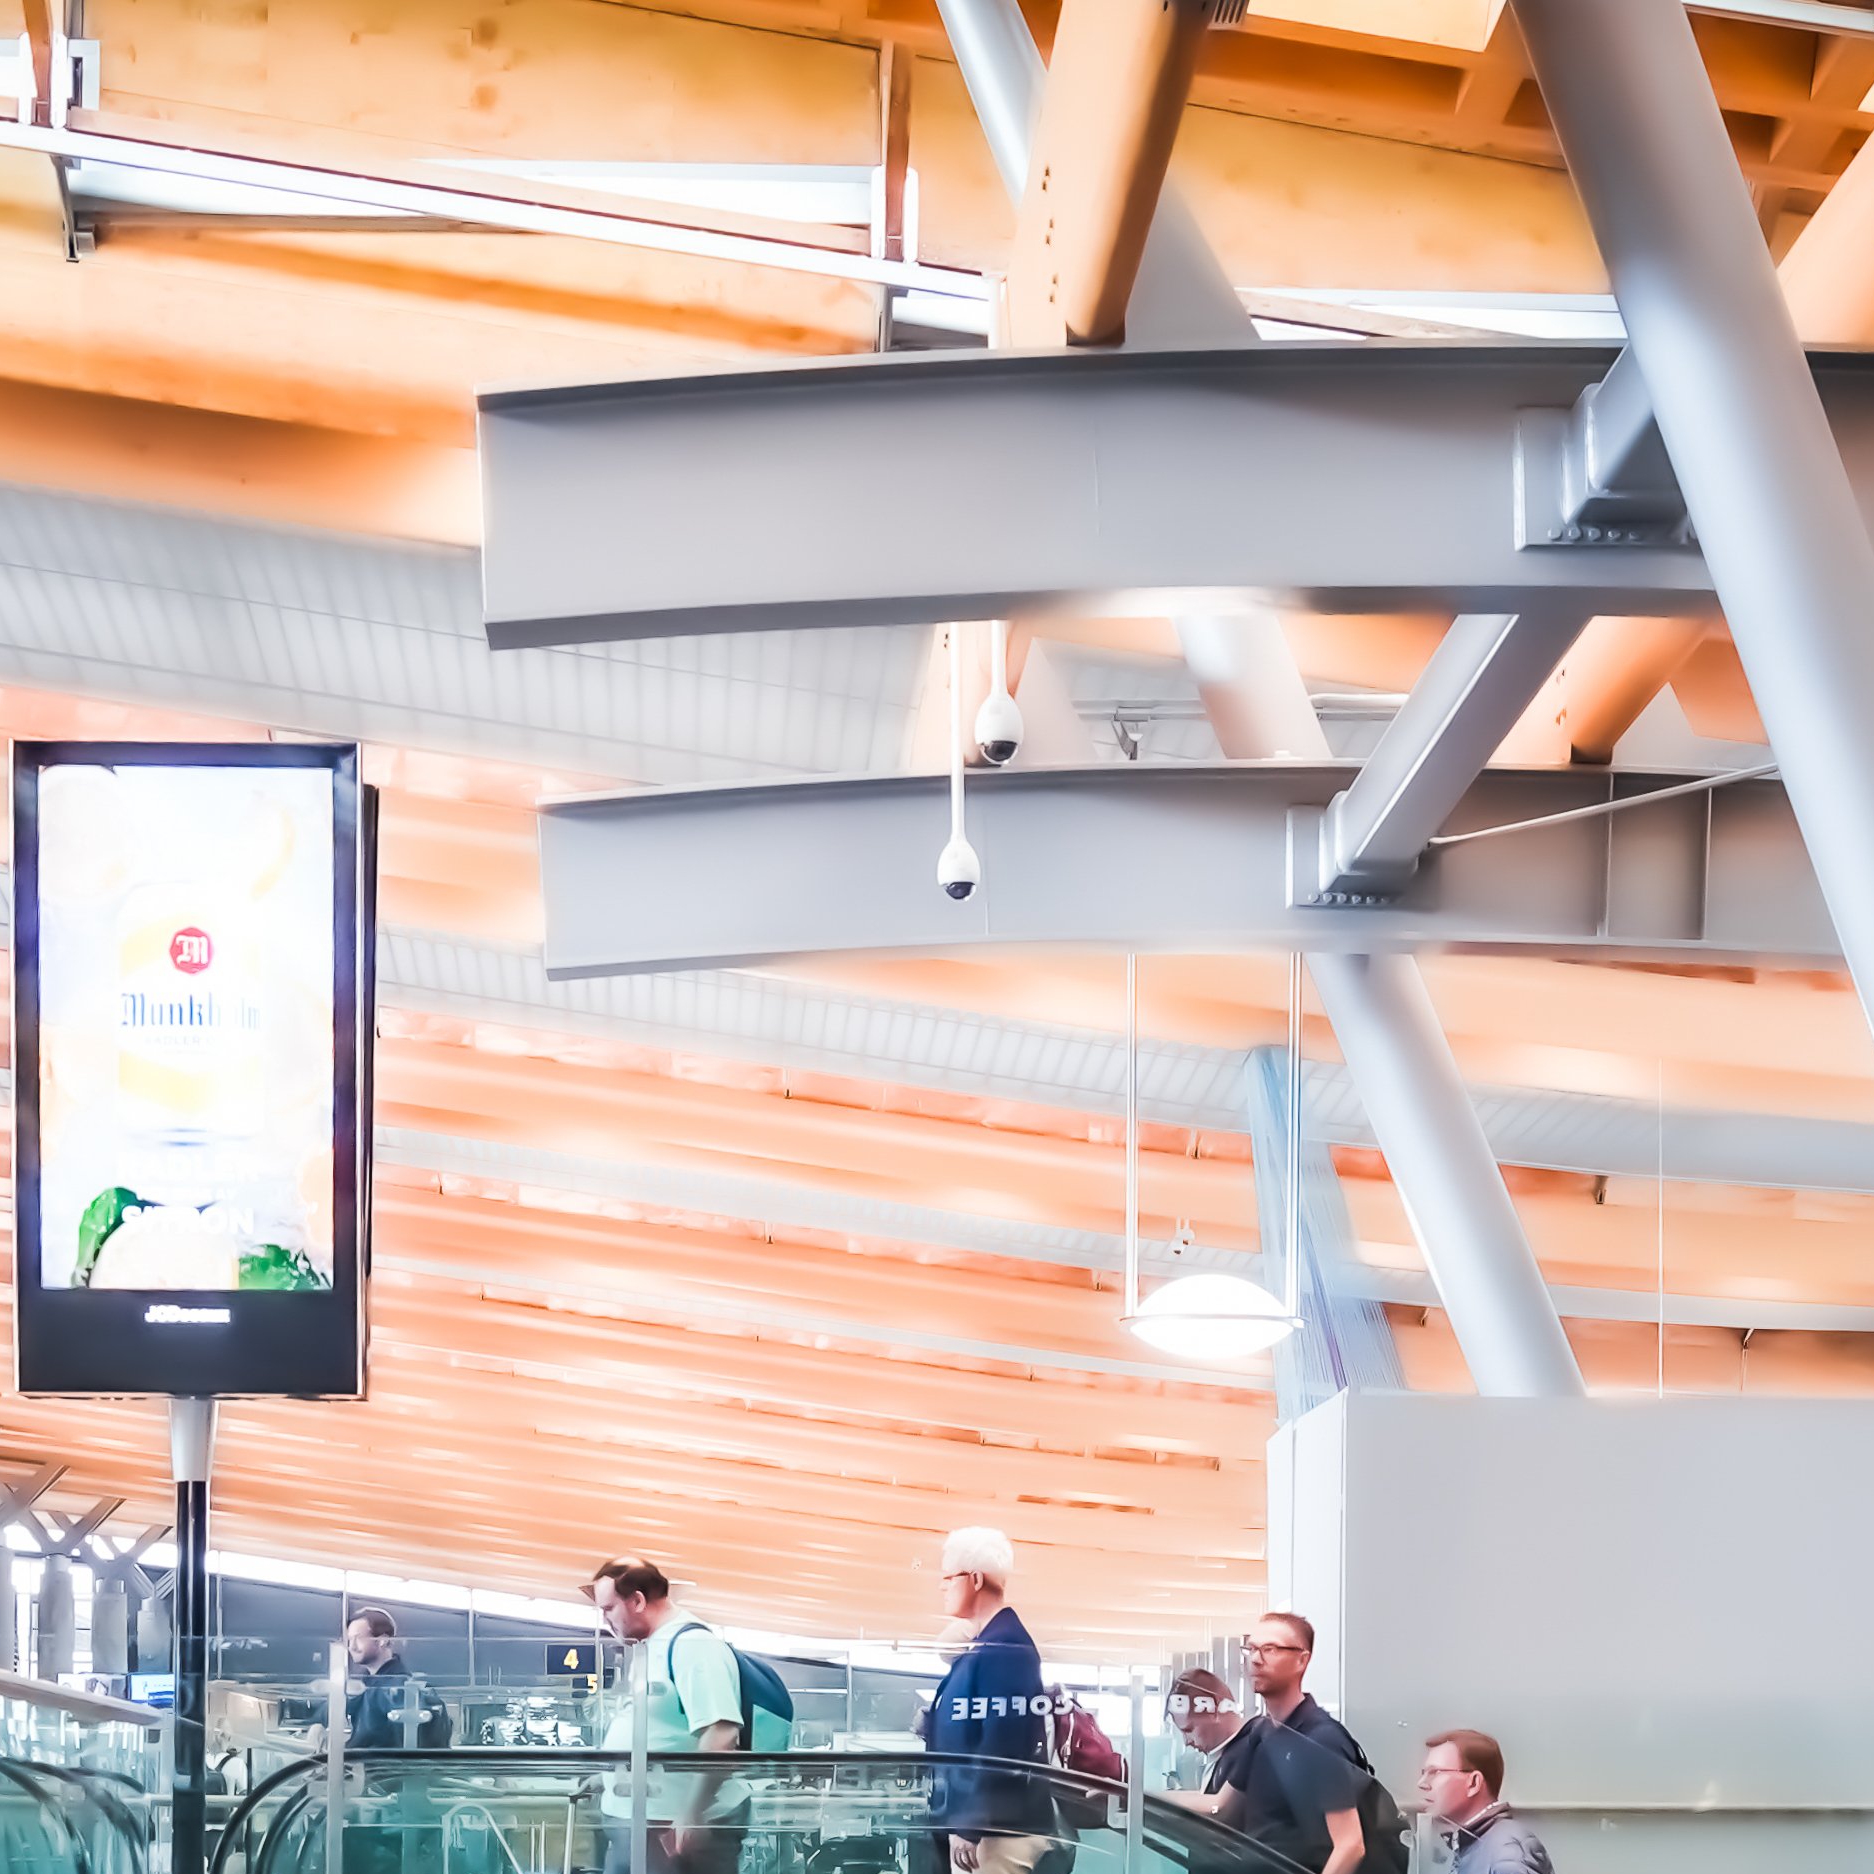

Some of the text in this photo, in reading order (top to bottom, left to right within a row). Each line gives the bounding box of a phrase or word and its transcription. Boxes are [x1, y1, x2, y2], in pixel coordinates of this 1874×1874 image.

[121, 991, 261, 1030] Munkhlm
[563, 1648, 579, 1670] 4
[587, 1673, 598, 1694] 5
